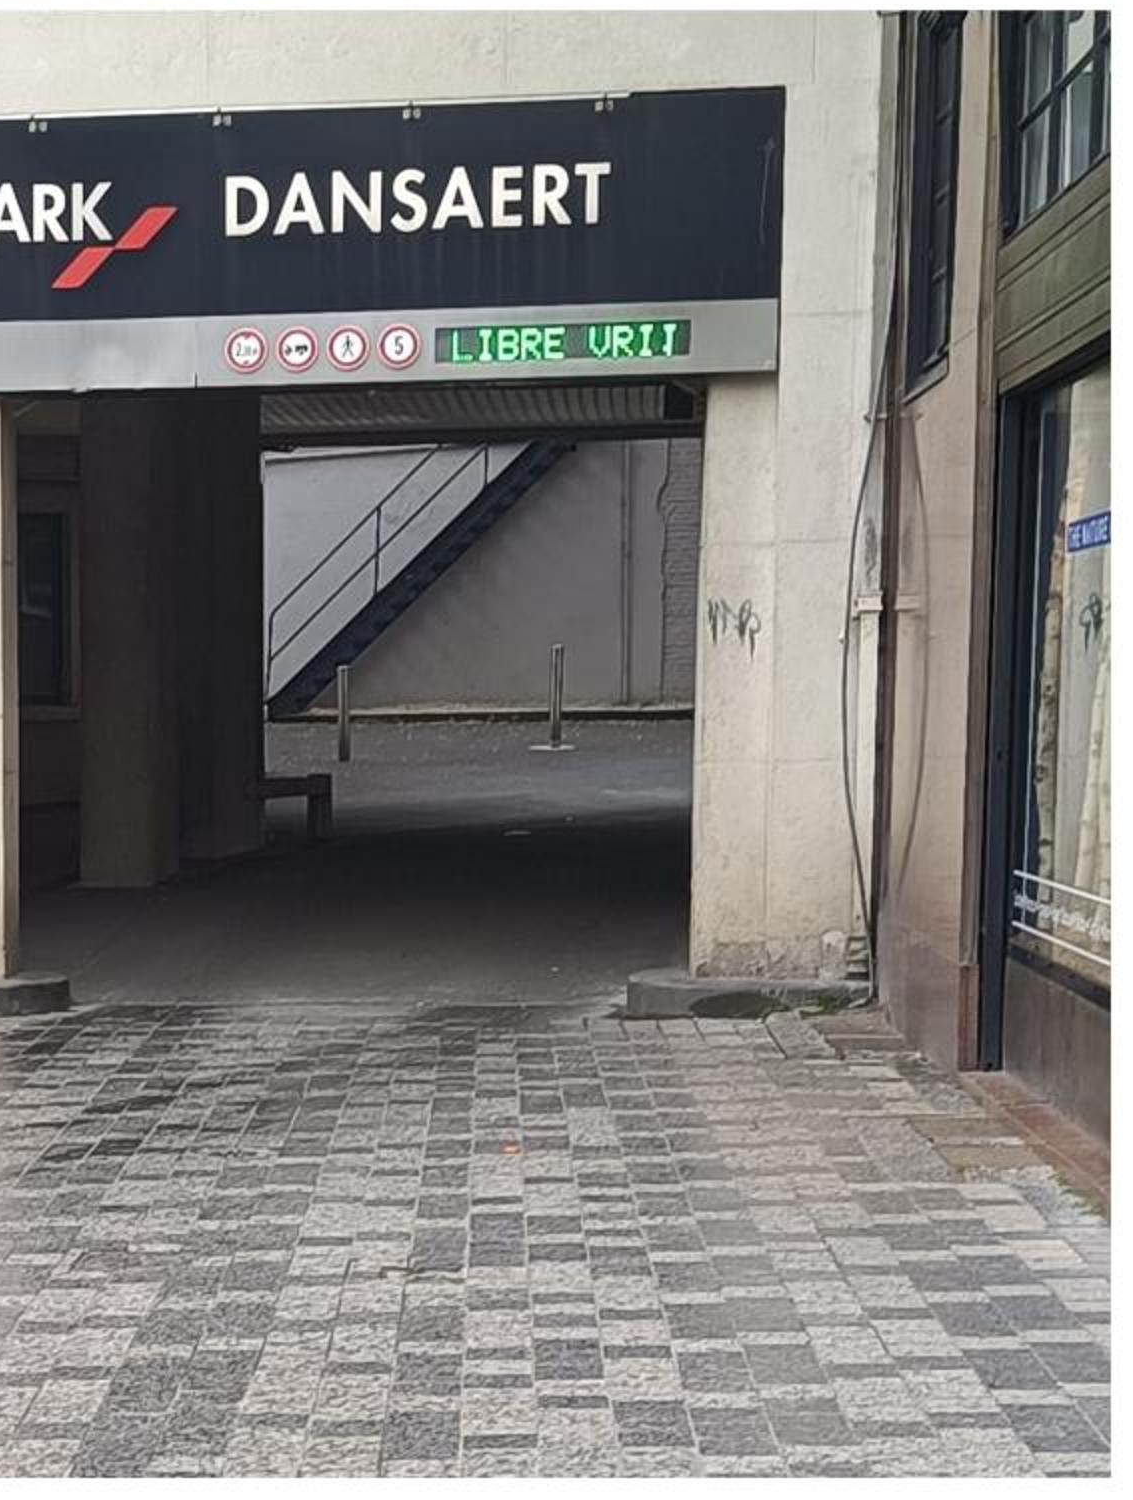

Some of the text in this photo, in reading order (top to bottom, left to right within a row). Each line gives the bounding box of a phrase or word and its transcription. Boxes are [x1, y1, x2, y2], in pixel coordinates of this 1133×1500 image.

[224, 161, 612, 238] DANSAERT
[394, 336, 405, 356] 5
[452, 327, 565, 361] LIBRE
